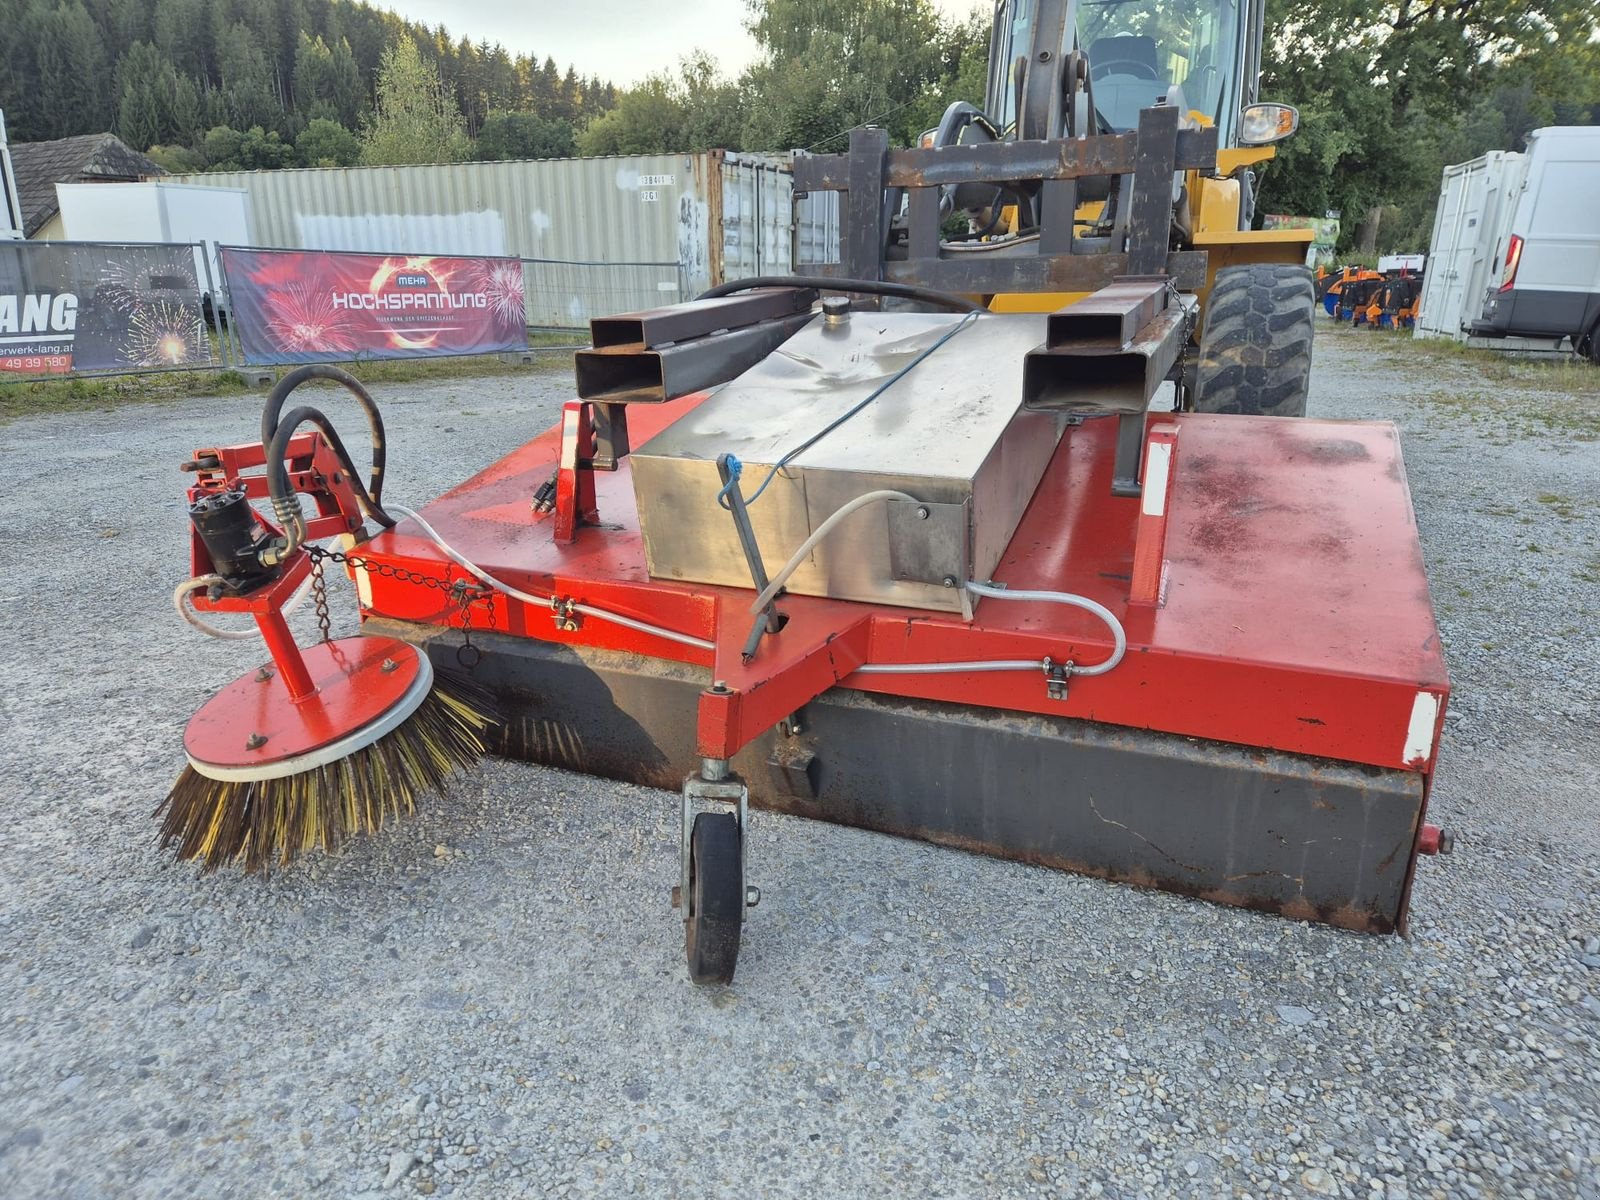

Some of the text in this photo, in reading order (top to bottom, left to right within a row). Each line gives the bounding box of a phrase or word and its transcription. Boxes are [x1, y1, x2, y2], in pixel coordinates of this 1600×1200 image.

[398, 276, 426, 285] MEHR
[332, 292, 487, 310] HOCHSPANNUNG
[5, 358, 22, 369] 49
[25, 357, 41, 368] 39
[44, 356, 67, 367] 580
